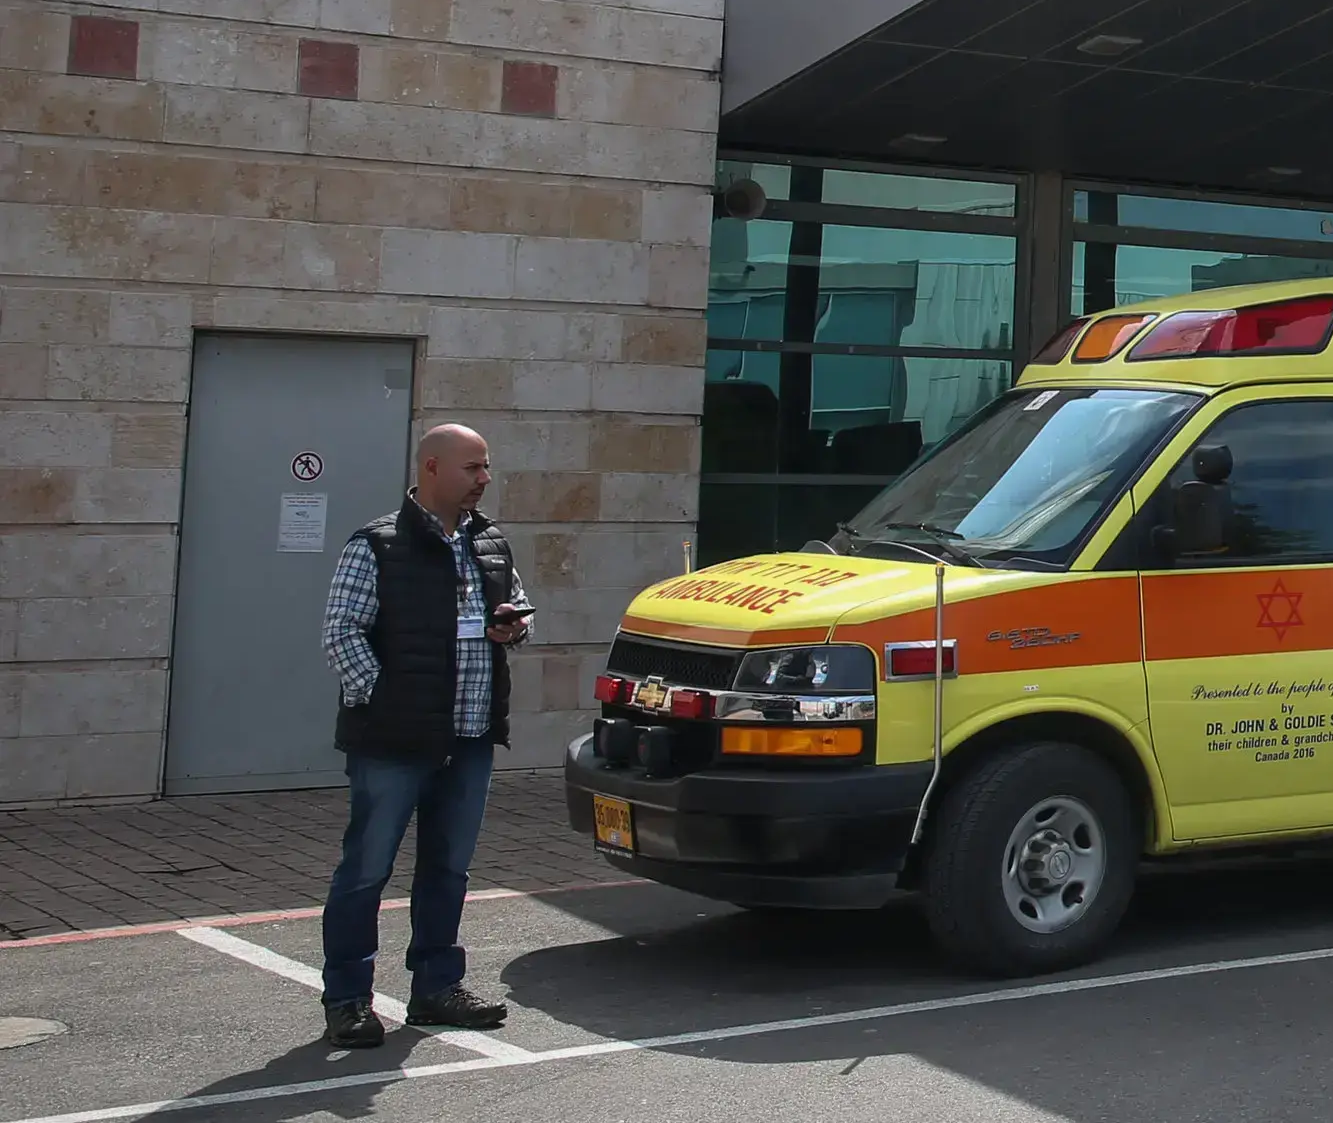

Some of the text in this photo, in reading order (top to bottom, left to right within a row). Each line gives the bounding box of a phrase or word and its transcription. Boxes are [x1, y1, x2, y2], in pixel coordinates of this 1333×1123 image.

[647, 579, 804, 614] AMBULANCE
[1191, 682, 1253, 700] Presented
[1253, 684, 1264, 697] to
[1266, 680, 1286, 695] the
[1286, 678, 1326, 699] people
[1281, 703, 1294, 714] by
[1206, 722, 1226, 736] DR.
[1231, 719, 1265, 734] JOHN
[1269, 718, 1279, 731] &
[1284, 714, 1326, 730] GOLDIE
[1208, 739, 1232, 752] their
[1236, 736, 1277, 749] children
[1281, 734, 1290, 745] &
[1255, 747, 1315, 762] Canada 2016
